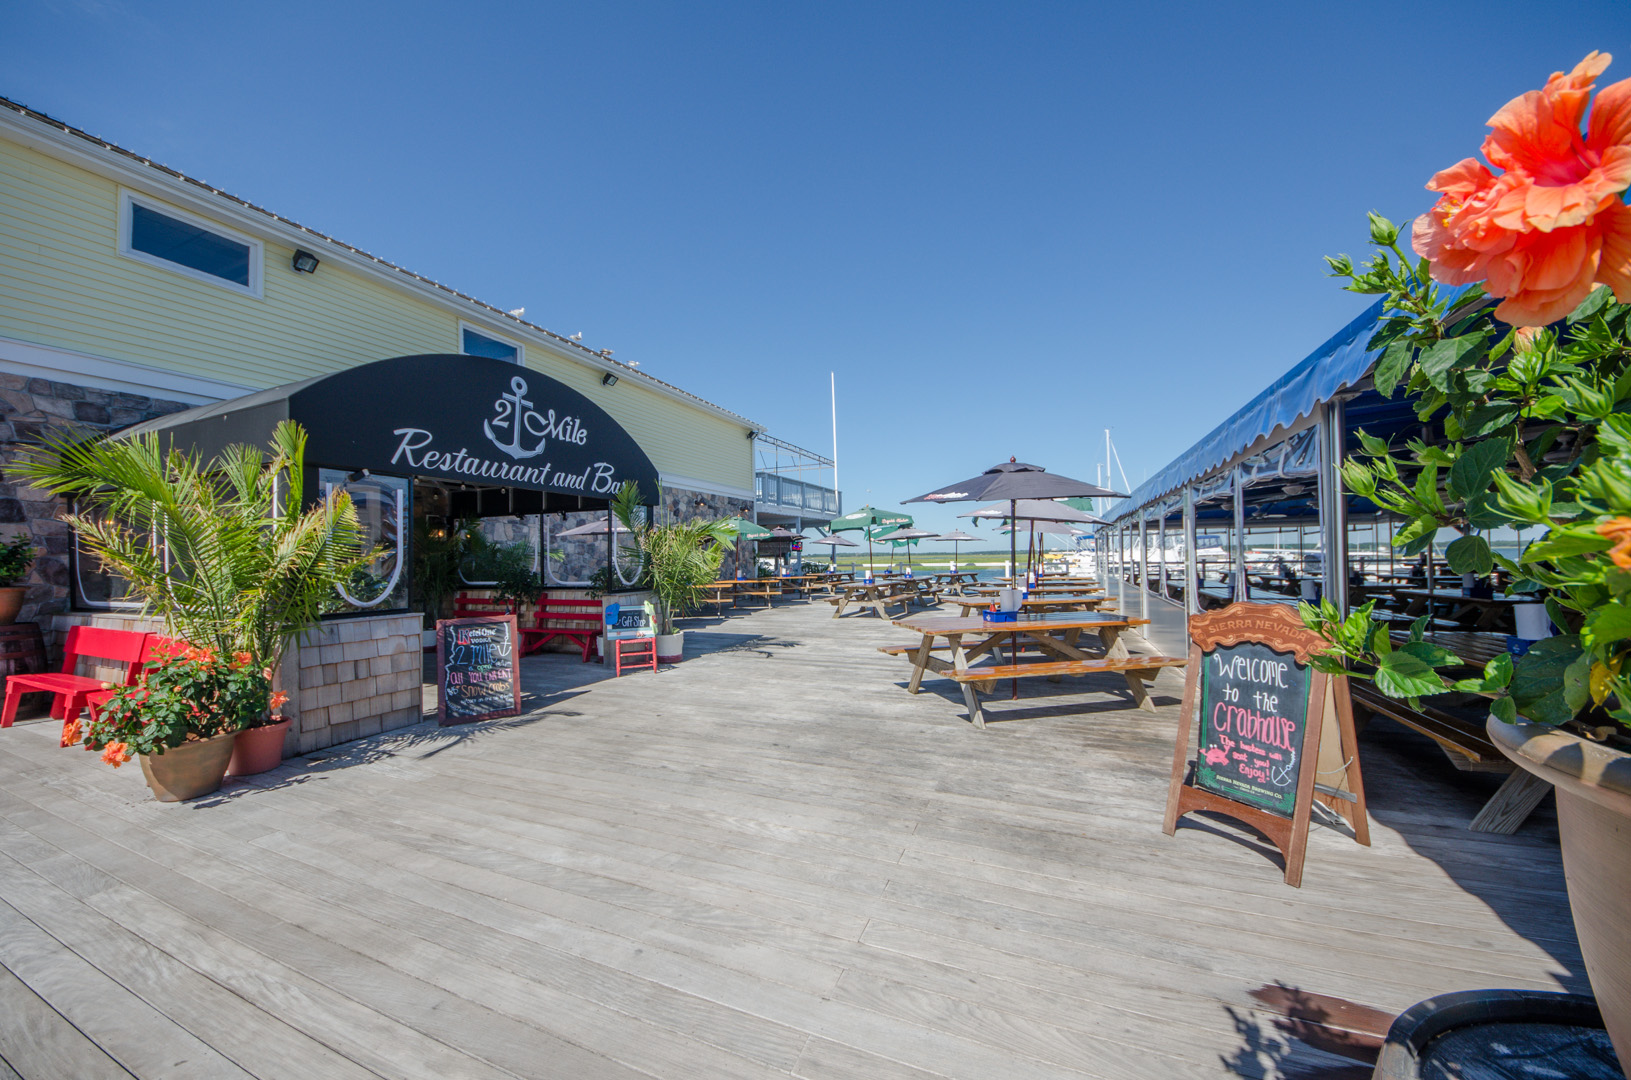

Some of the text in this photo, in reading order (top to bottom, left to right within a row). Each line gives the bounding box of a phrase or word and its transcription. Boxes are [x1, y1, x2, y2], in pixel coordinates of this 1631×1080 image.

[492, 399, 588, 446] 2 Mile
[390, 427, 551, 486] Restaurant
[549, 466, 591, 490] and
[481, 628, 496, 637] One
[1208, 619, 1306, 642] SIERRA NEVADA
[455, 645, 469, 665] 2
[1213, 653, 1288, 688] Welcome
[1222, 682, 1278, 712] to the
[1213, 701, 1296, 752] Crabhouse
[1219, 734, 1236, 748] The
[1239, 763, 1270, 783] Enjoy!
